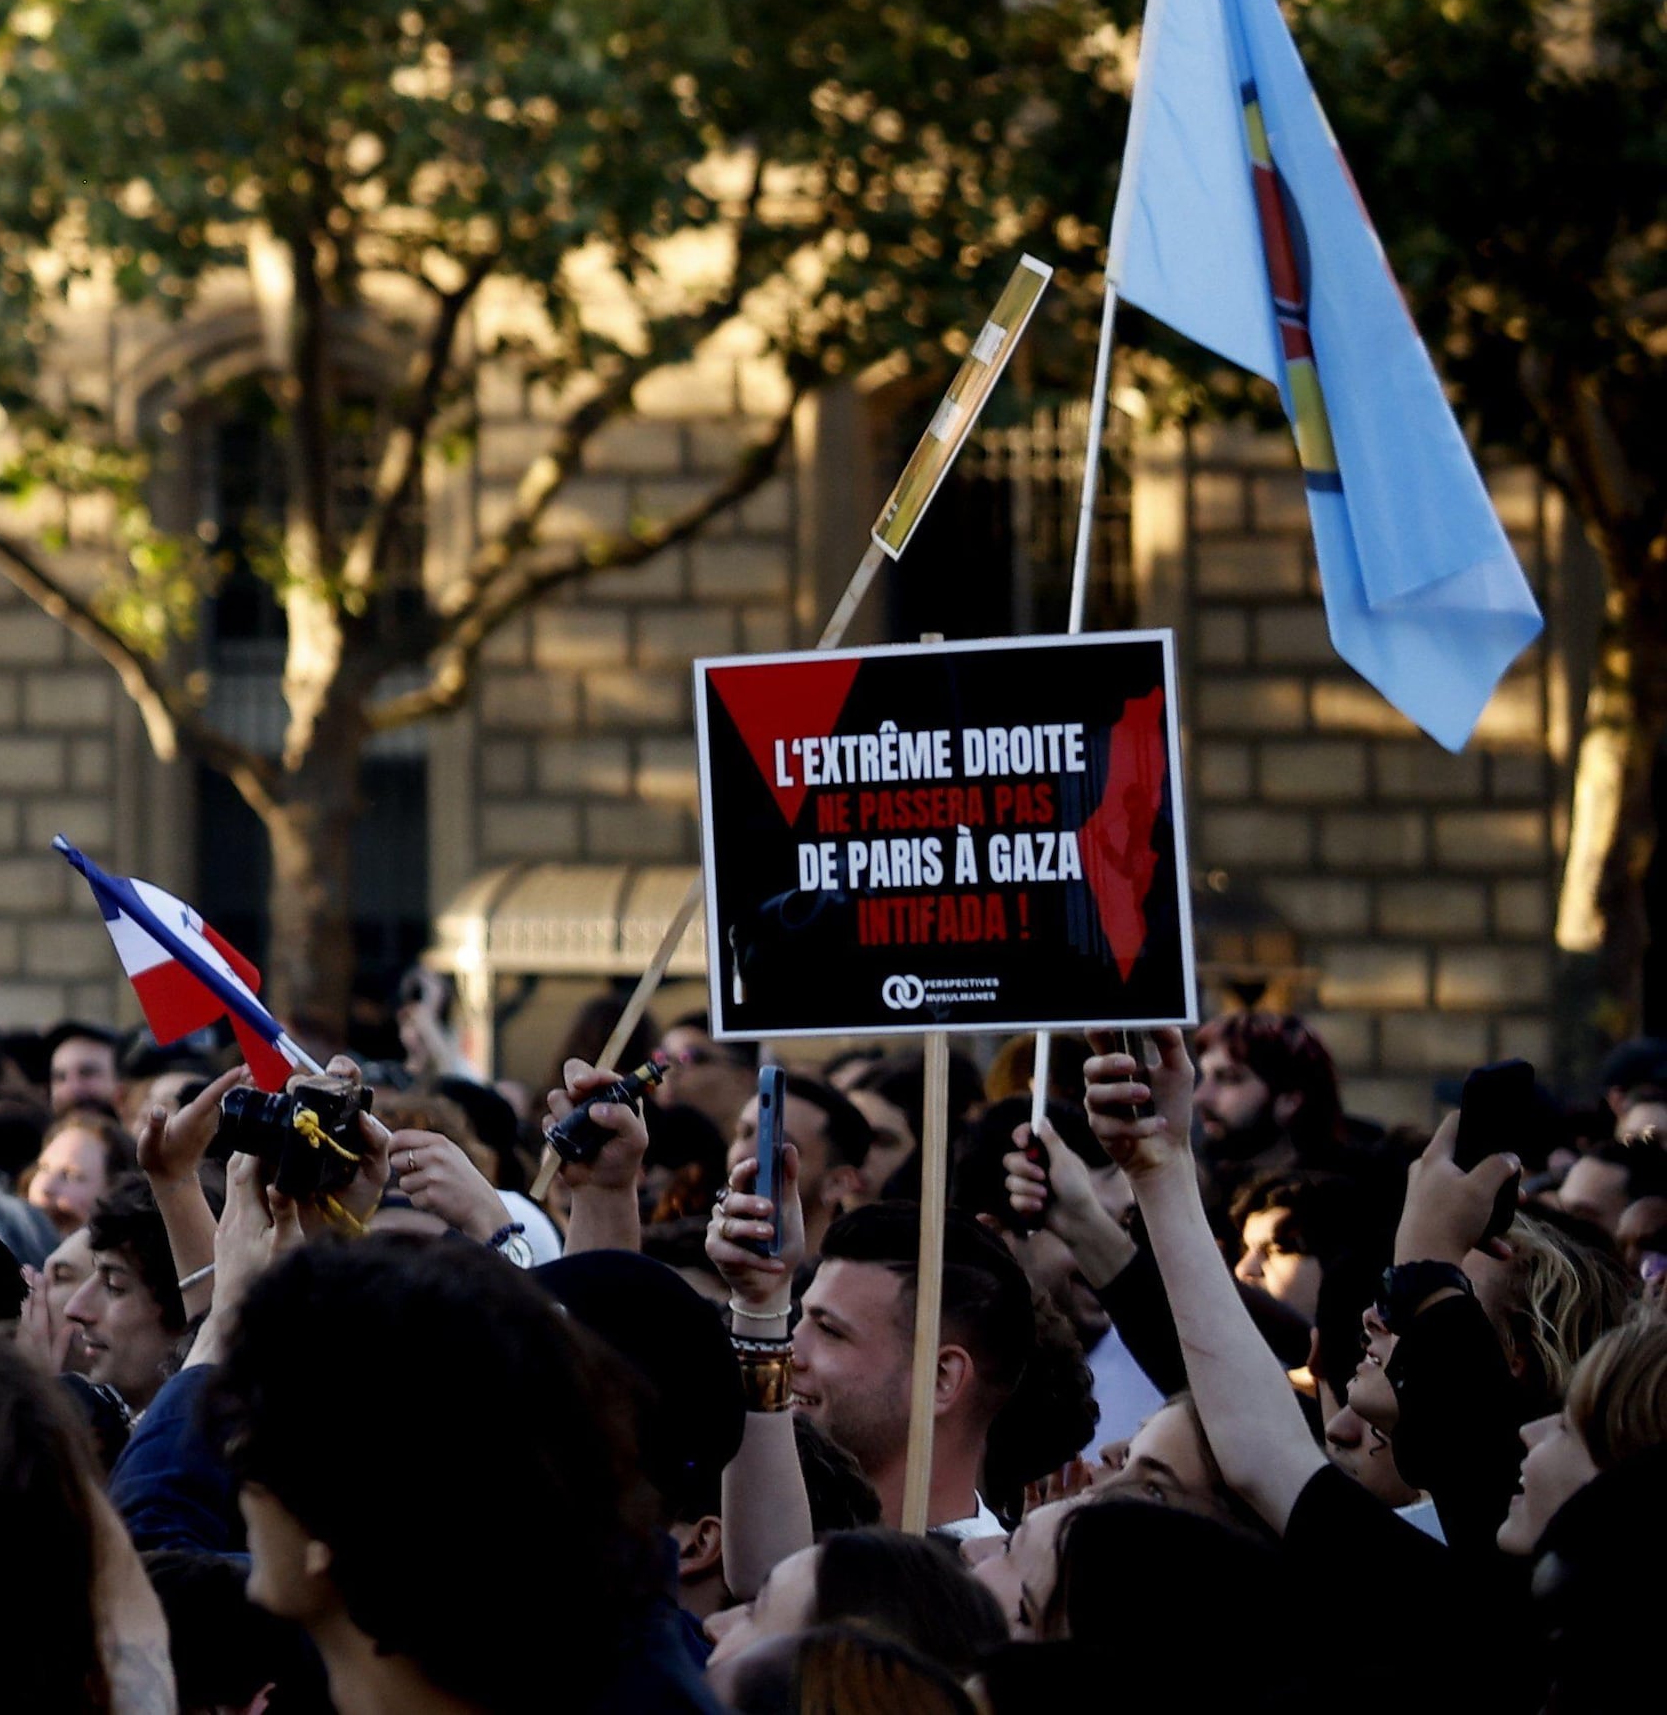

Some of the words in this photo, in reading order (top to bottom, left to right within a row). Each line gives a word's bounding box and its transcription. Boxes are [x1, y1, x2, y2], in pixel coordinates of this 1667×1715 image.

[775, 720, 953, 787] L'EXTRÊME
[962, 723, 1086, 777] DROITE
[818, 793, 851, 833] NE
[859, 786, 985, 831] PASSERA
[994, 782, 1054, 825] PAS
[798, 842, 839, 891] DE
[848, 836, 943, 889] PARIS
[955, 823, 978, 884] À
[988, 831, 1083, 883] GAZA
[858, 893, 1007, 946] INTIFADA
[1018, 892, 1030, 940] !
[924, 977, 1000, 989] PERSPECTIVES
[925, 991, 997, 1003] MUSULMANES
